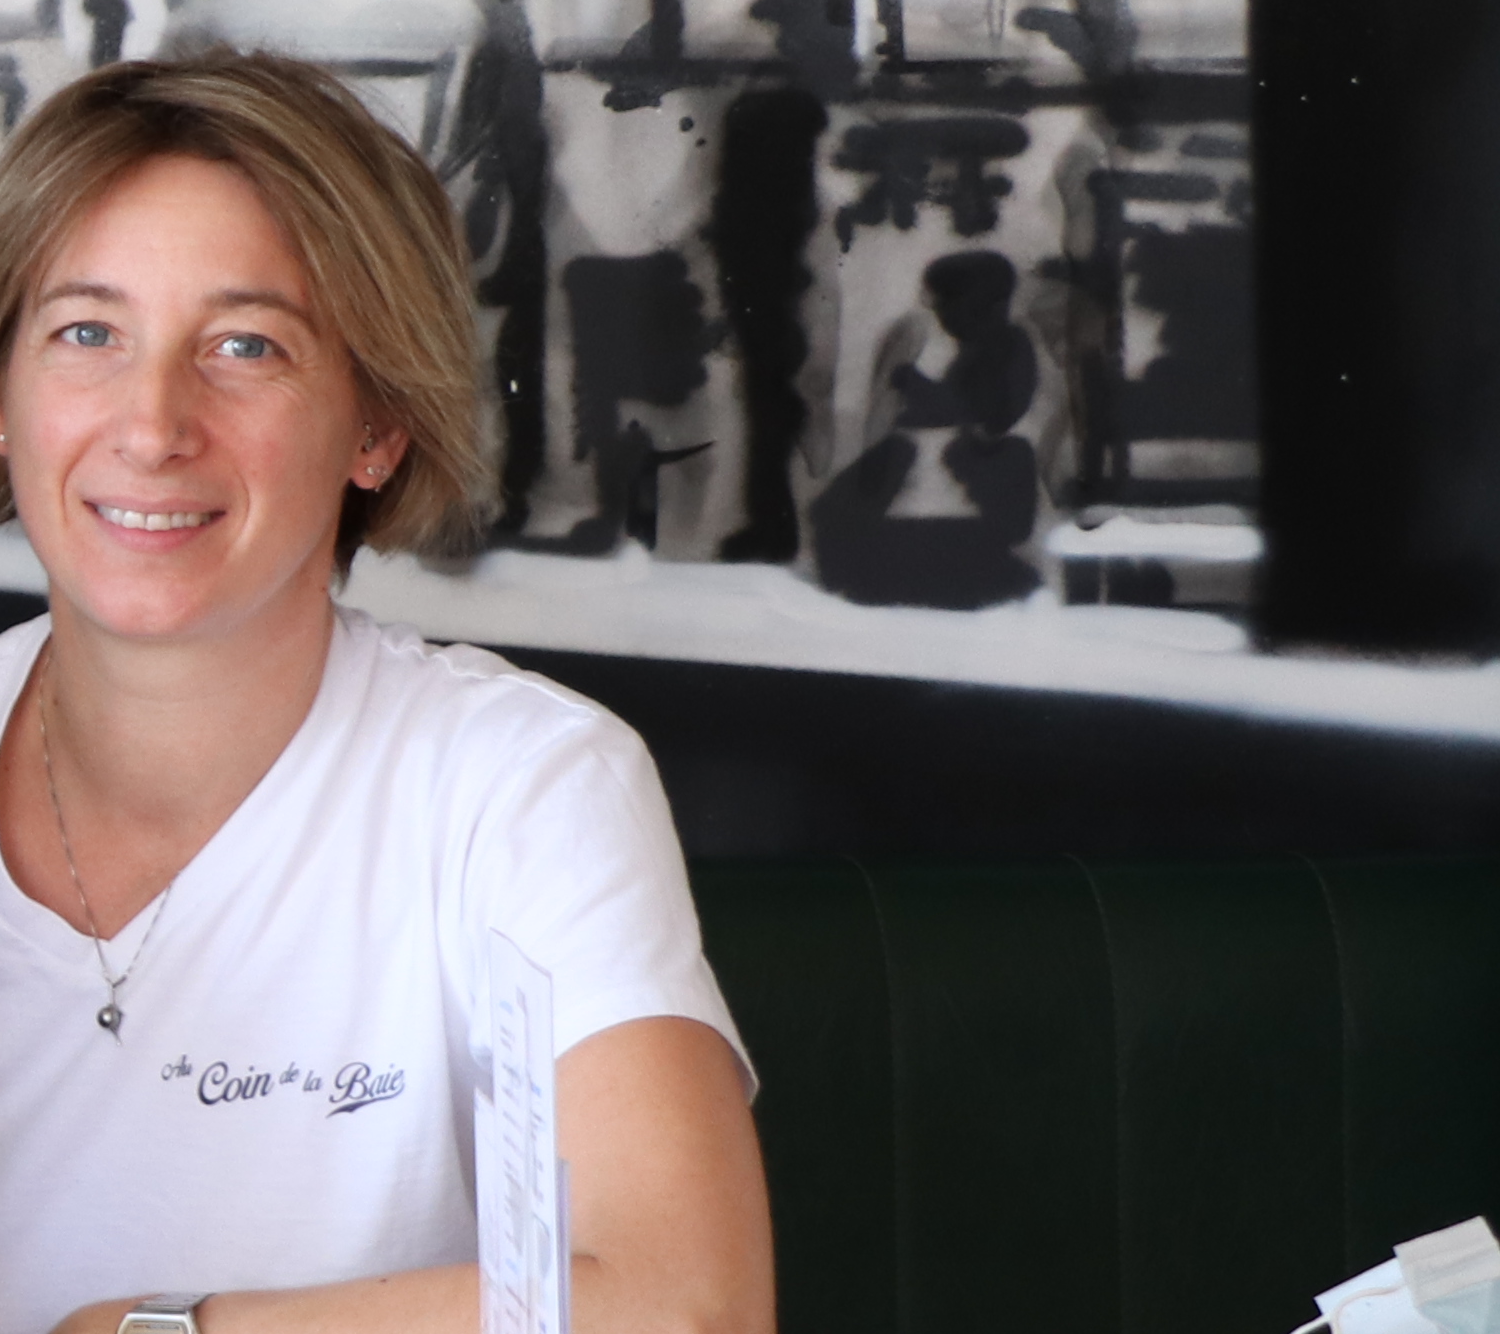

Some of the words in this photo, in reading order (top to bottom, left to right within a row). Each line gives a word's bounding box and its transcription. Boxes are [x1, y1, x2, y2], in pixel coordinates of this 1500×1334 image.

[161, 1054, 193, 1082] Au
[197, 1061, 273, 1106] Coin
[279, 1061, 301, 1085] de
[303, 1070, 323, 1093] la
[327, 1062, 406, 1117] Baie
